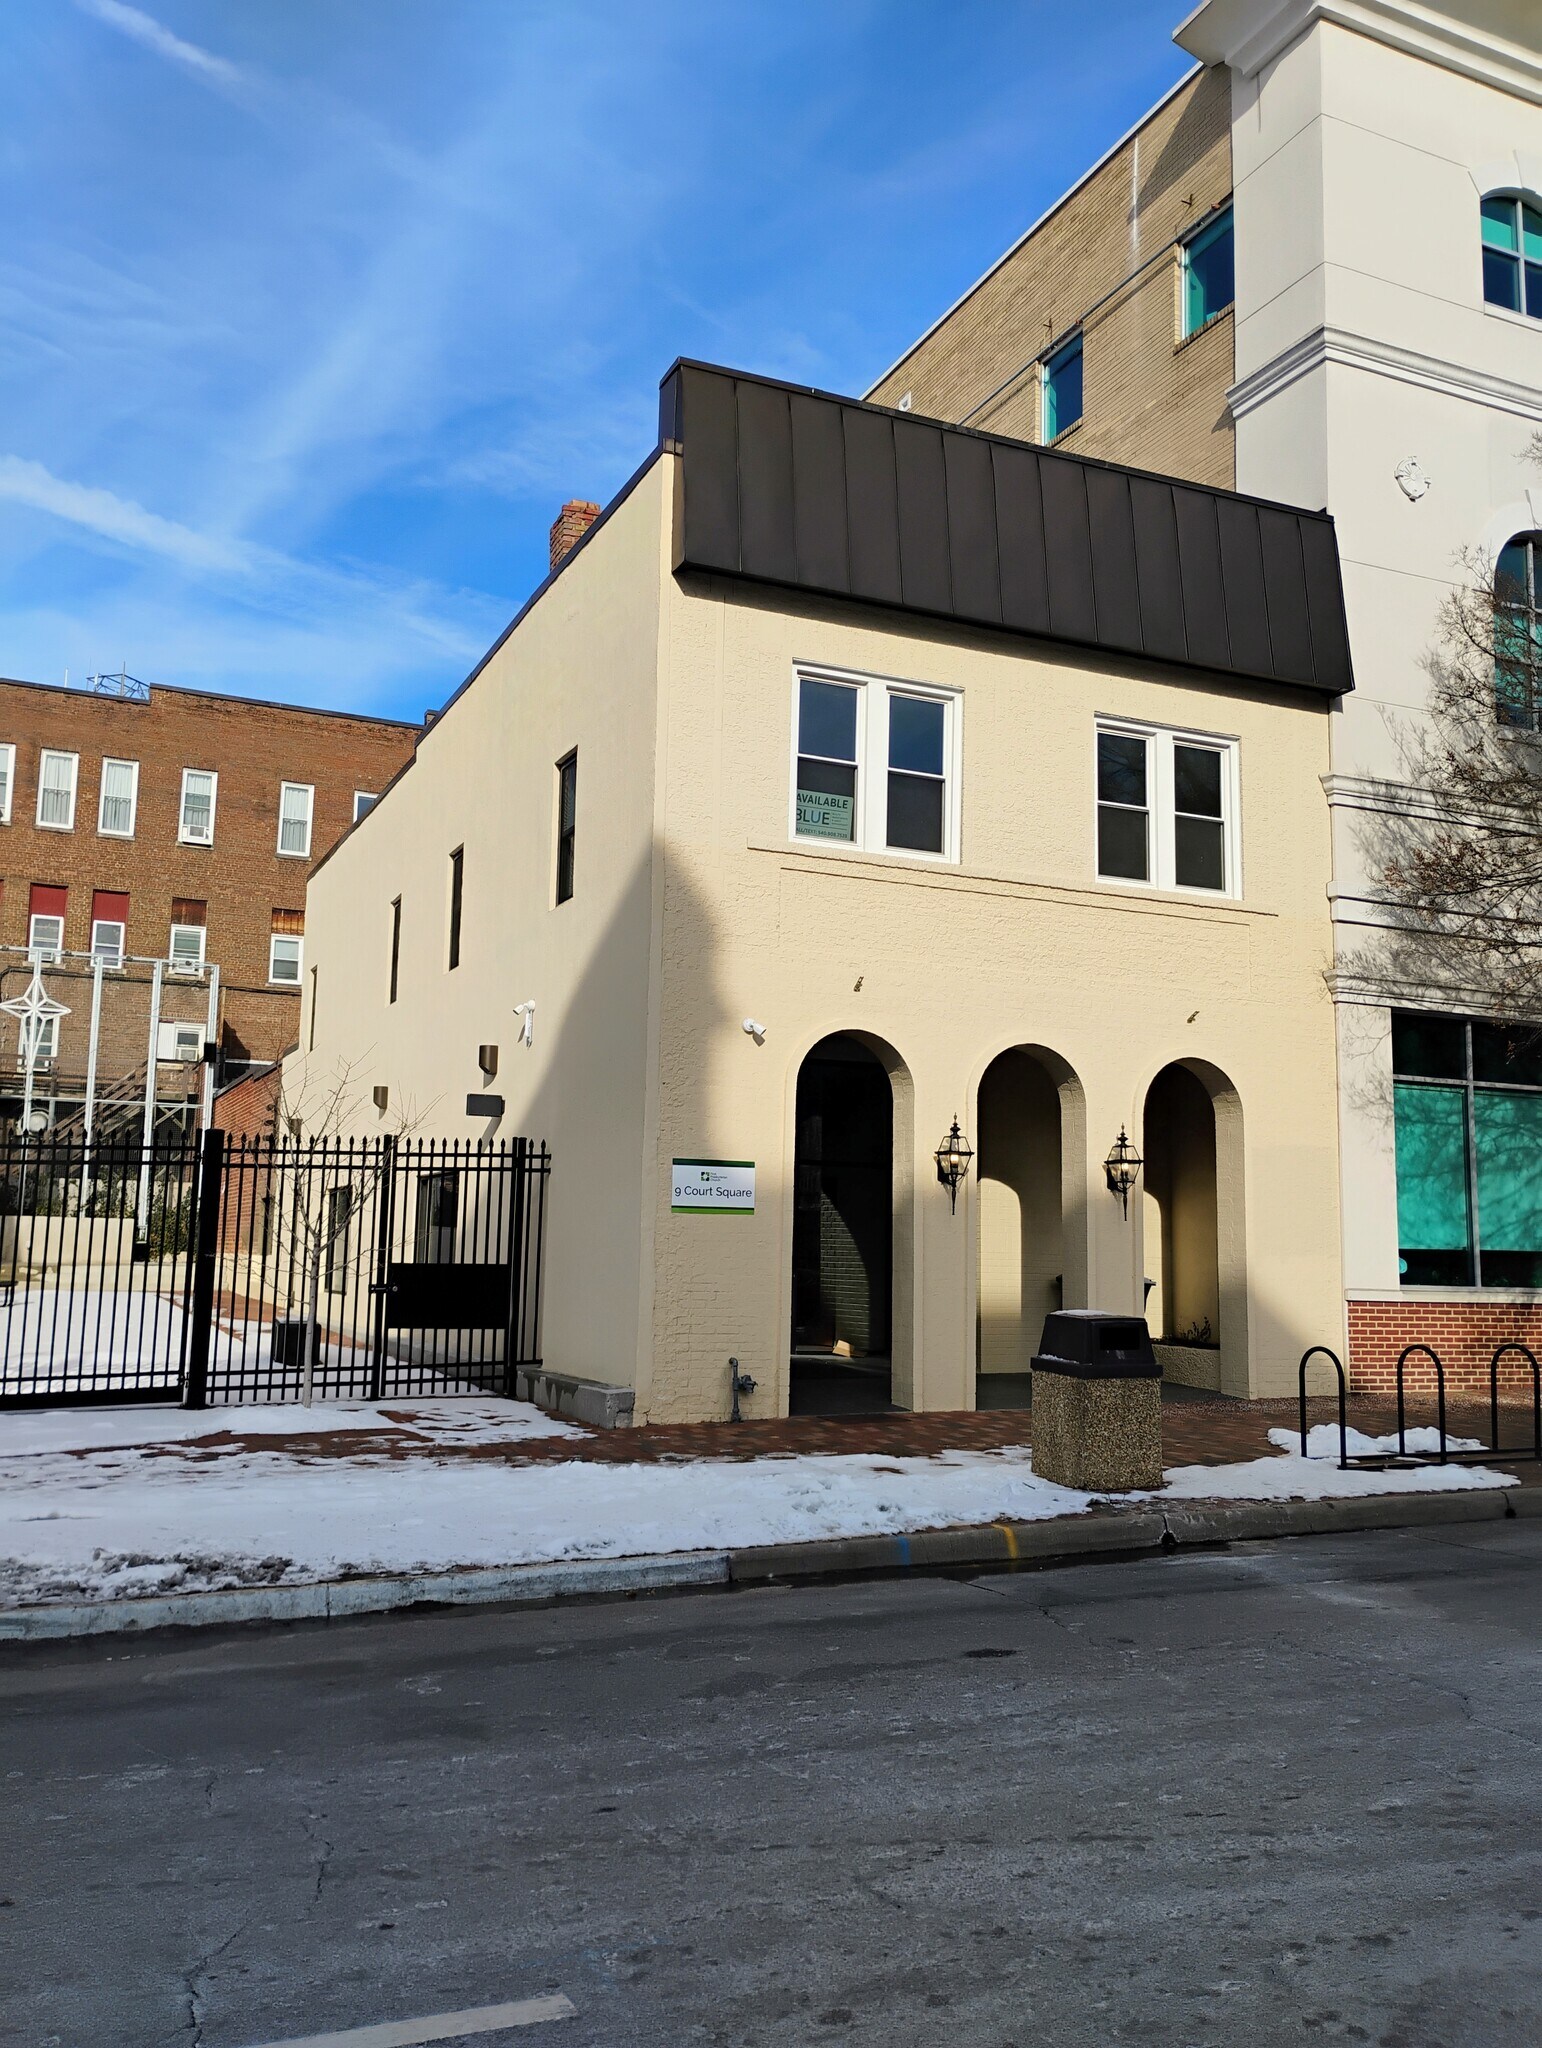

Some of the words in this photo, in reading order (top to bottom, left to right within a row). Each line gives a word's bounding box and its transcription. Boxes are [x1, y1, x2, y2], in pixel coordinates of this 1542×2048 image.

[797, 793, 848, 809] AVAILABLE
[796, 808, 830, 825] BLUE
[674, 1187, 681, 1197] 9
[684, 1185, 713, 1196] Court
[716, 1186, 752, 1198] Square
